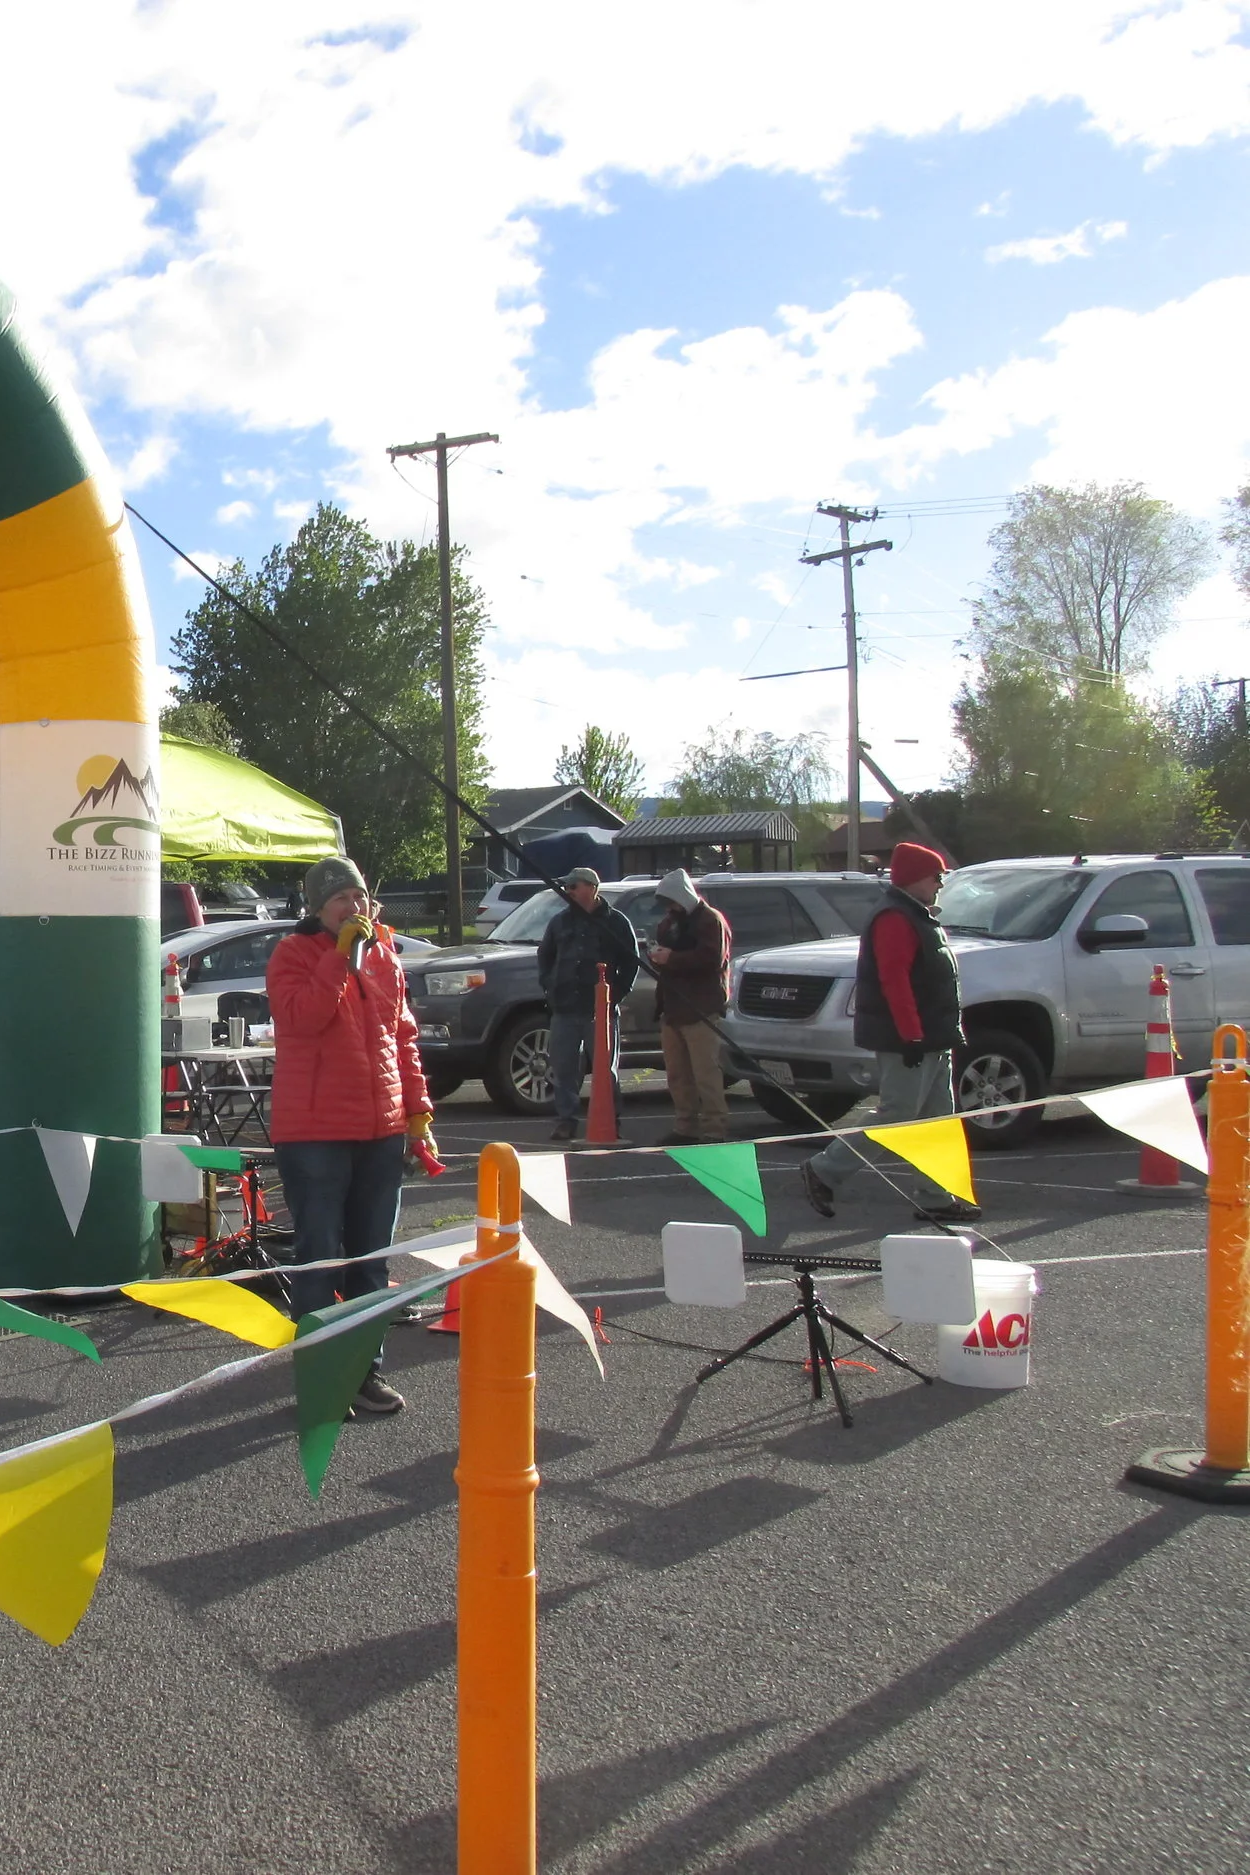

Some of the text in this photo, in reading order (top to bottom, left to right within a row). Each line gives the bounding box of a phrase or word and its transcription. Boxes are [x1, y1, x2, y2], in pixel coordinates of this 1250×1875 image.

[46, 847, 79, 860] THE
[85, 847, 117, 860] BIZZ
[761, 986, 799, 1000] GMC
[963, 1347, 981, 1356] The
[983, 1350, 1018, 1358] helpful
